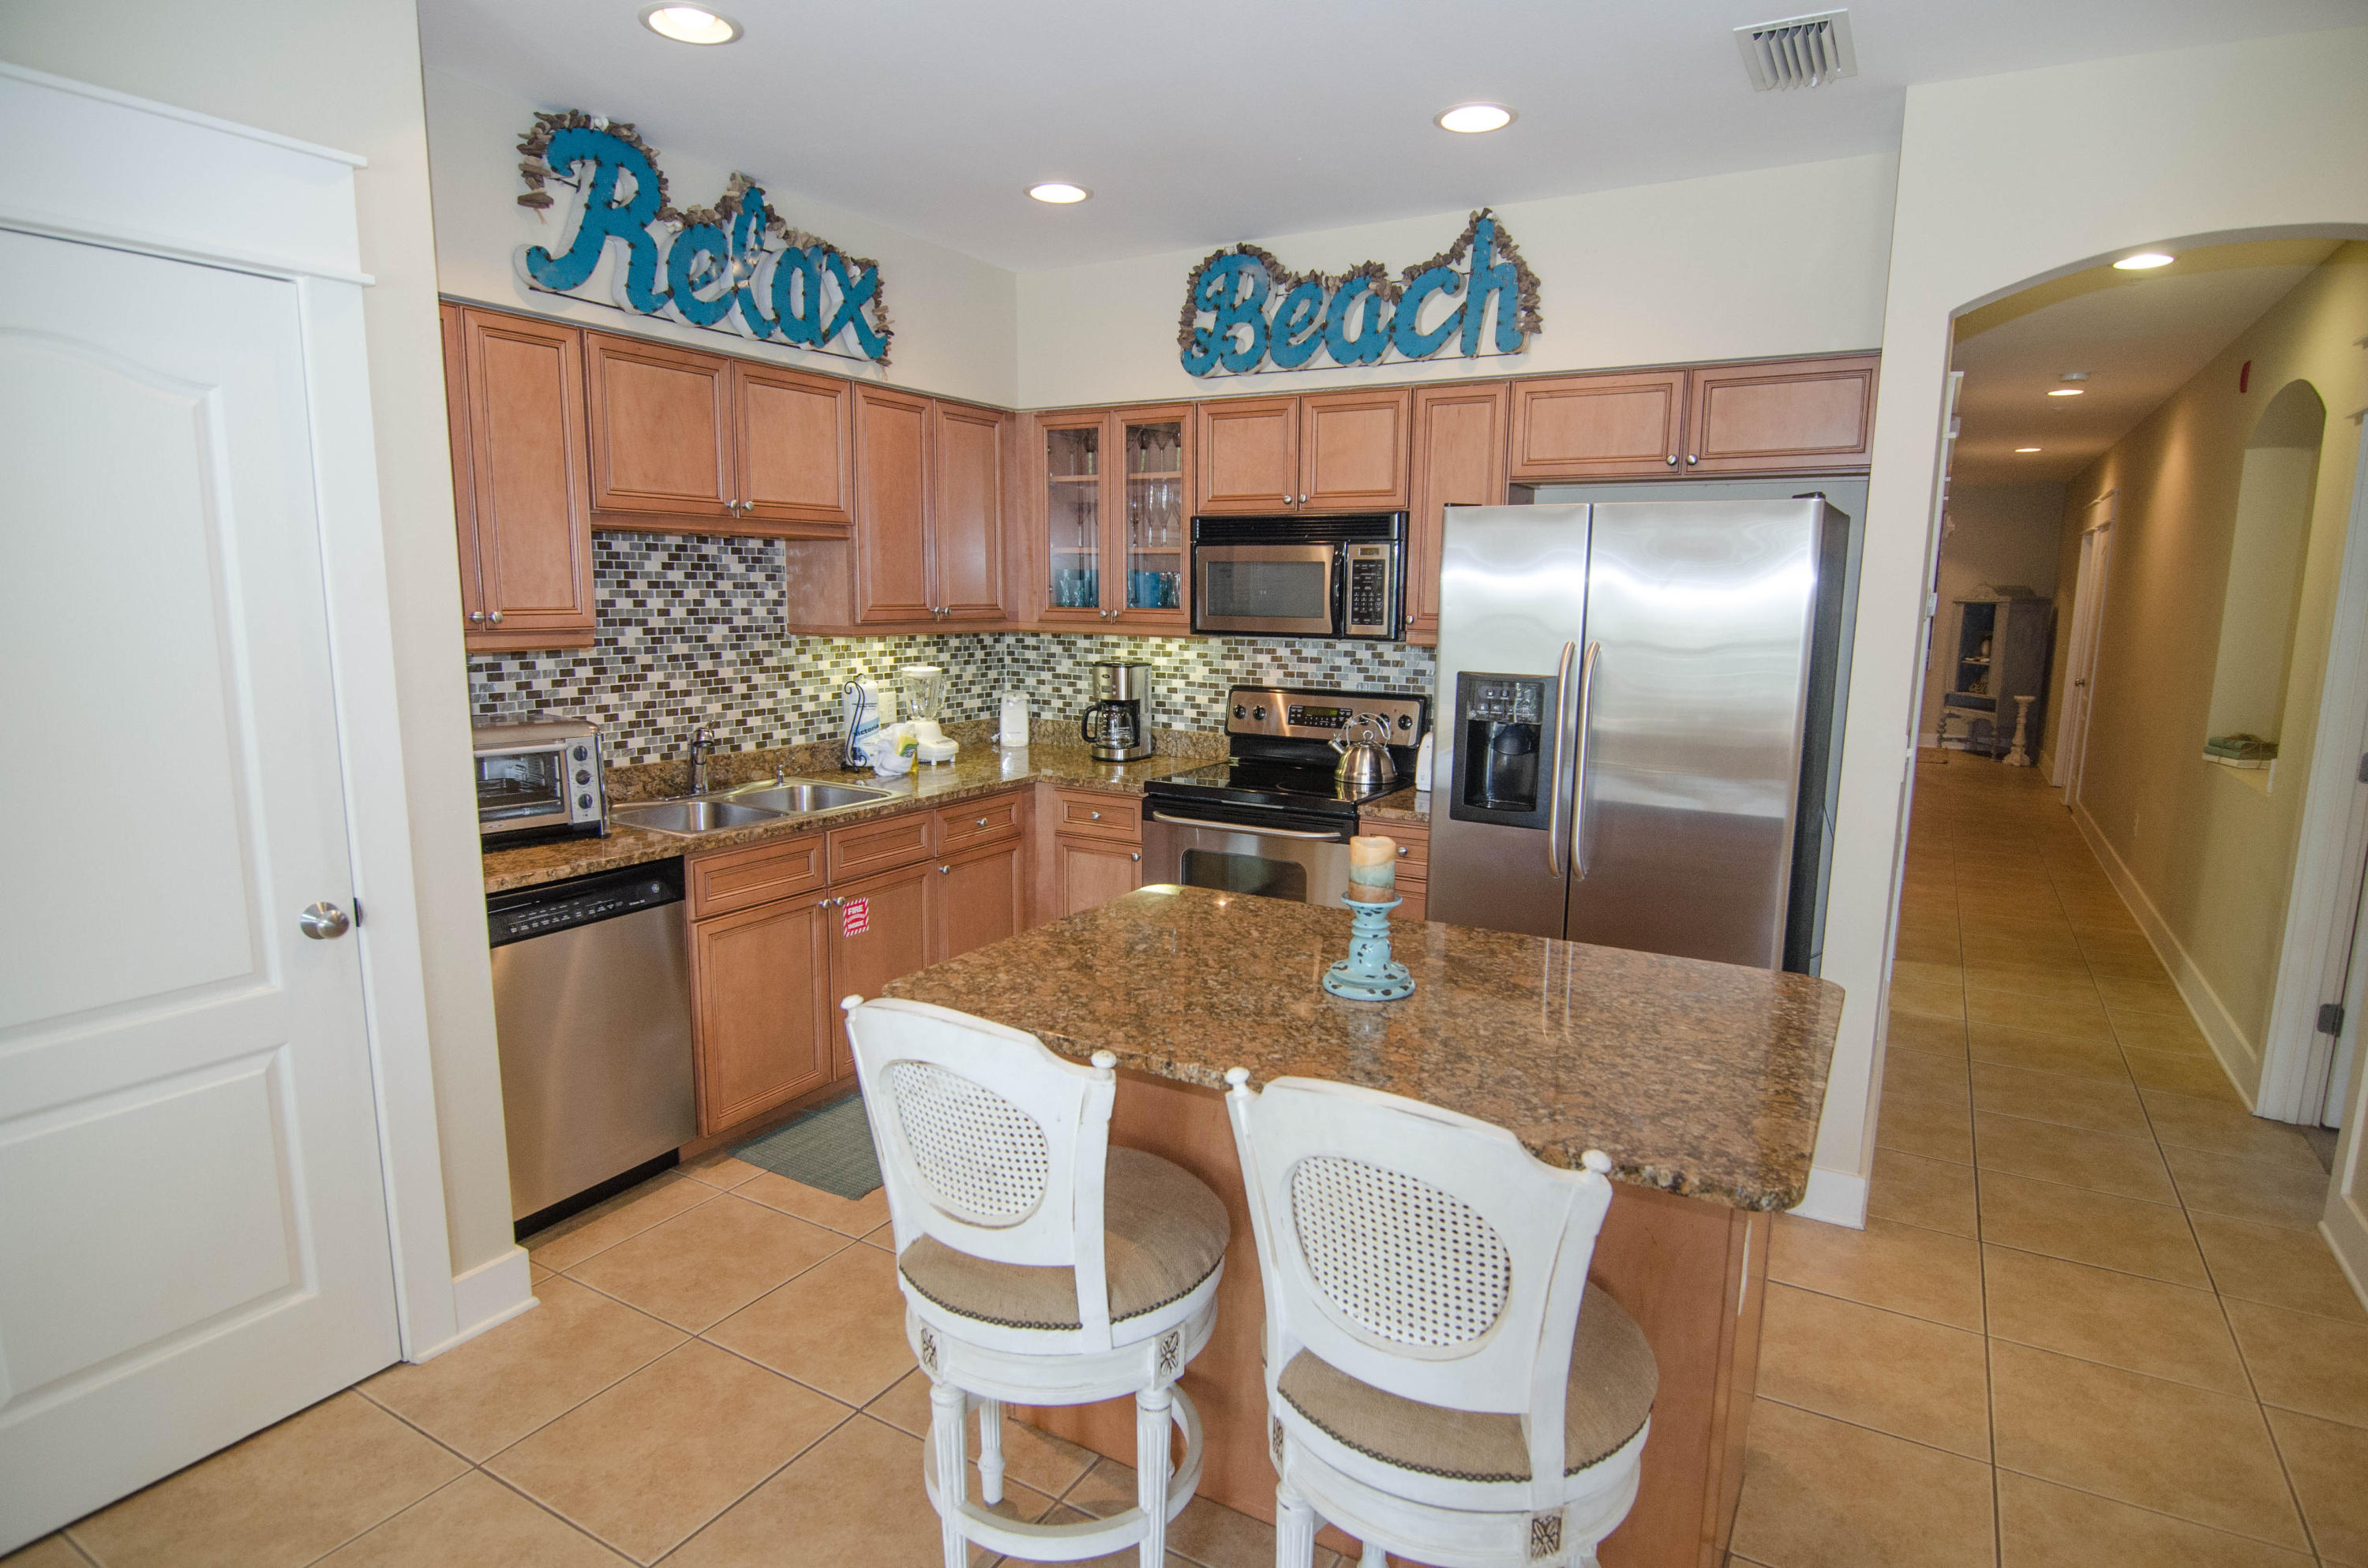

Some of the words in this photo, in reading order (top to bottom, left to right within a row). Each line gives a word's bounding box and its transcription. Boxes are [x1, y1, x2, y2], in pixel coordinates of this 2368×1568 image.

[521, 126, 888, 360] Relax
[1181, 217, 1524, 378] Beach
[847, 904, 864, 915] FIRE
